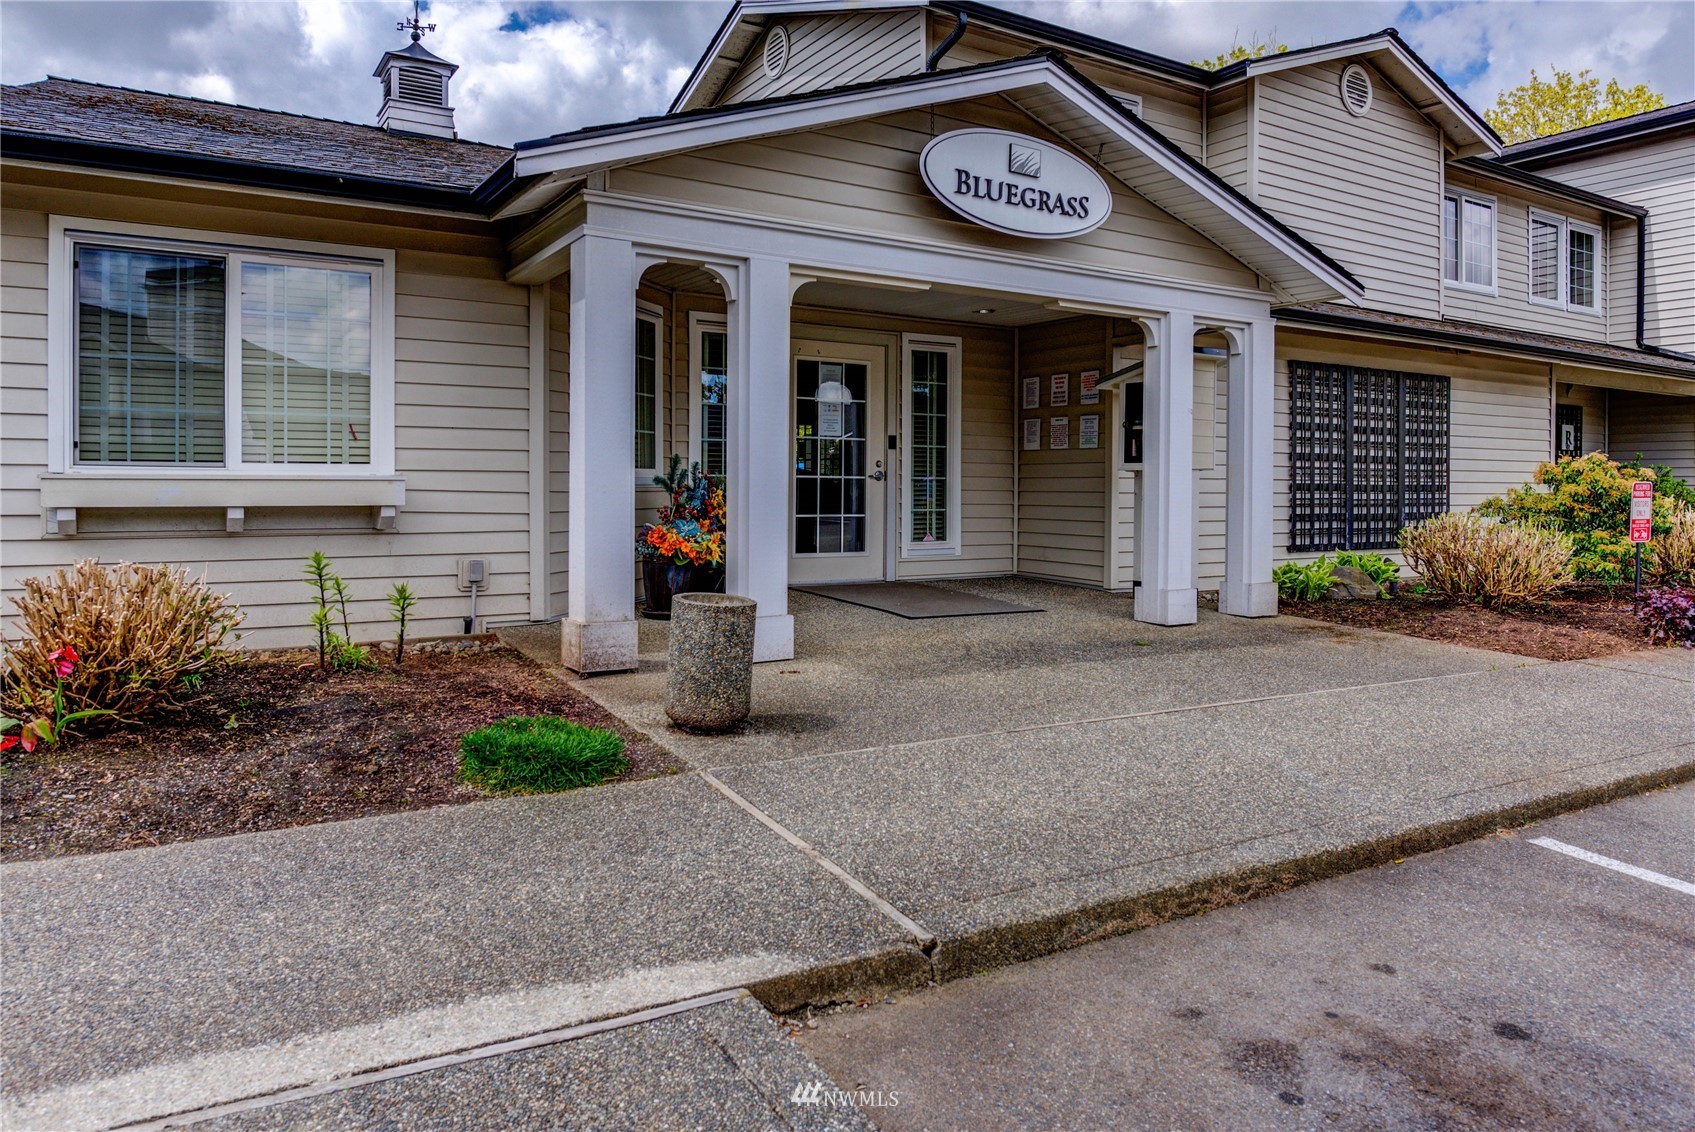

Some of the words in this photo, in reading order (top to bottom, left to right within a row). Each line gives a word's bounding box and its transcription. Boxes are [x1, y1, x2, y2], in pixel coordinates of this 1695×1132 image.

[428, 23, 436, 32] W
[954, 168, 1090, 220] BLUEGRASS
[1565, 430, 1572, 445] R
